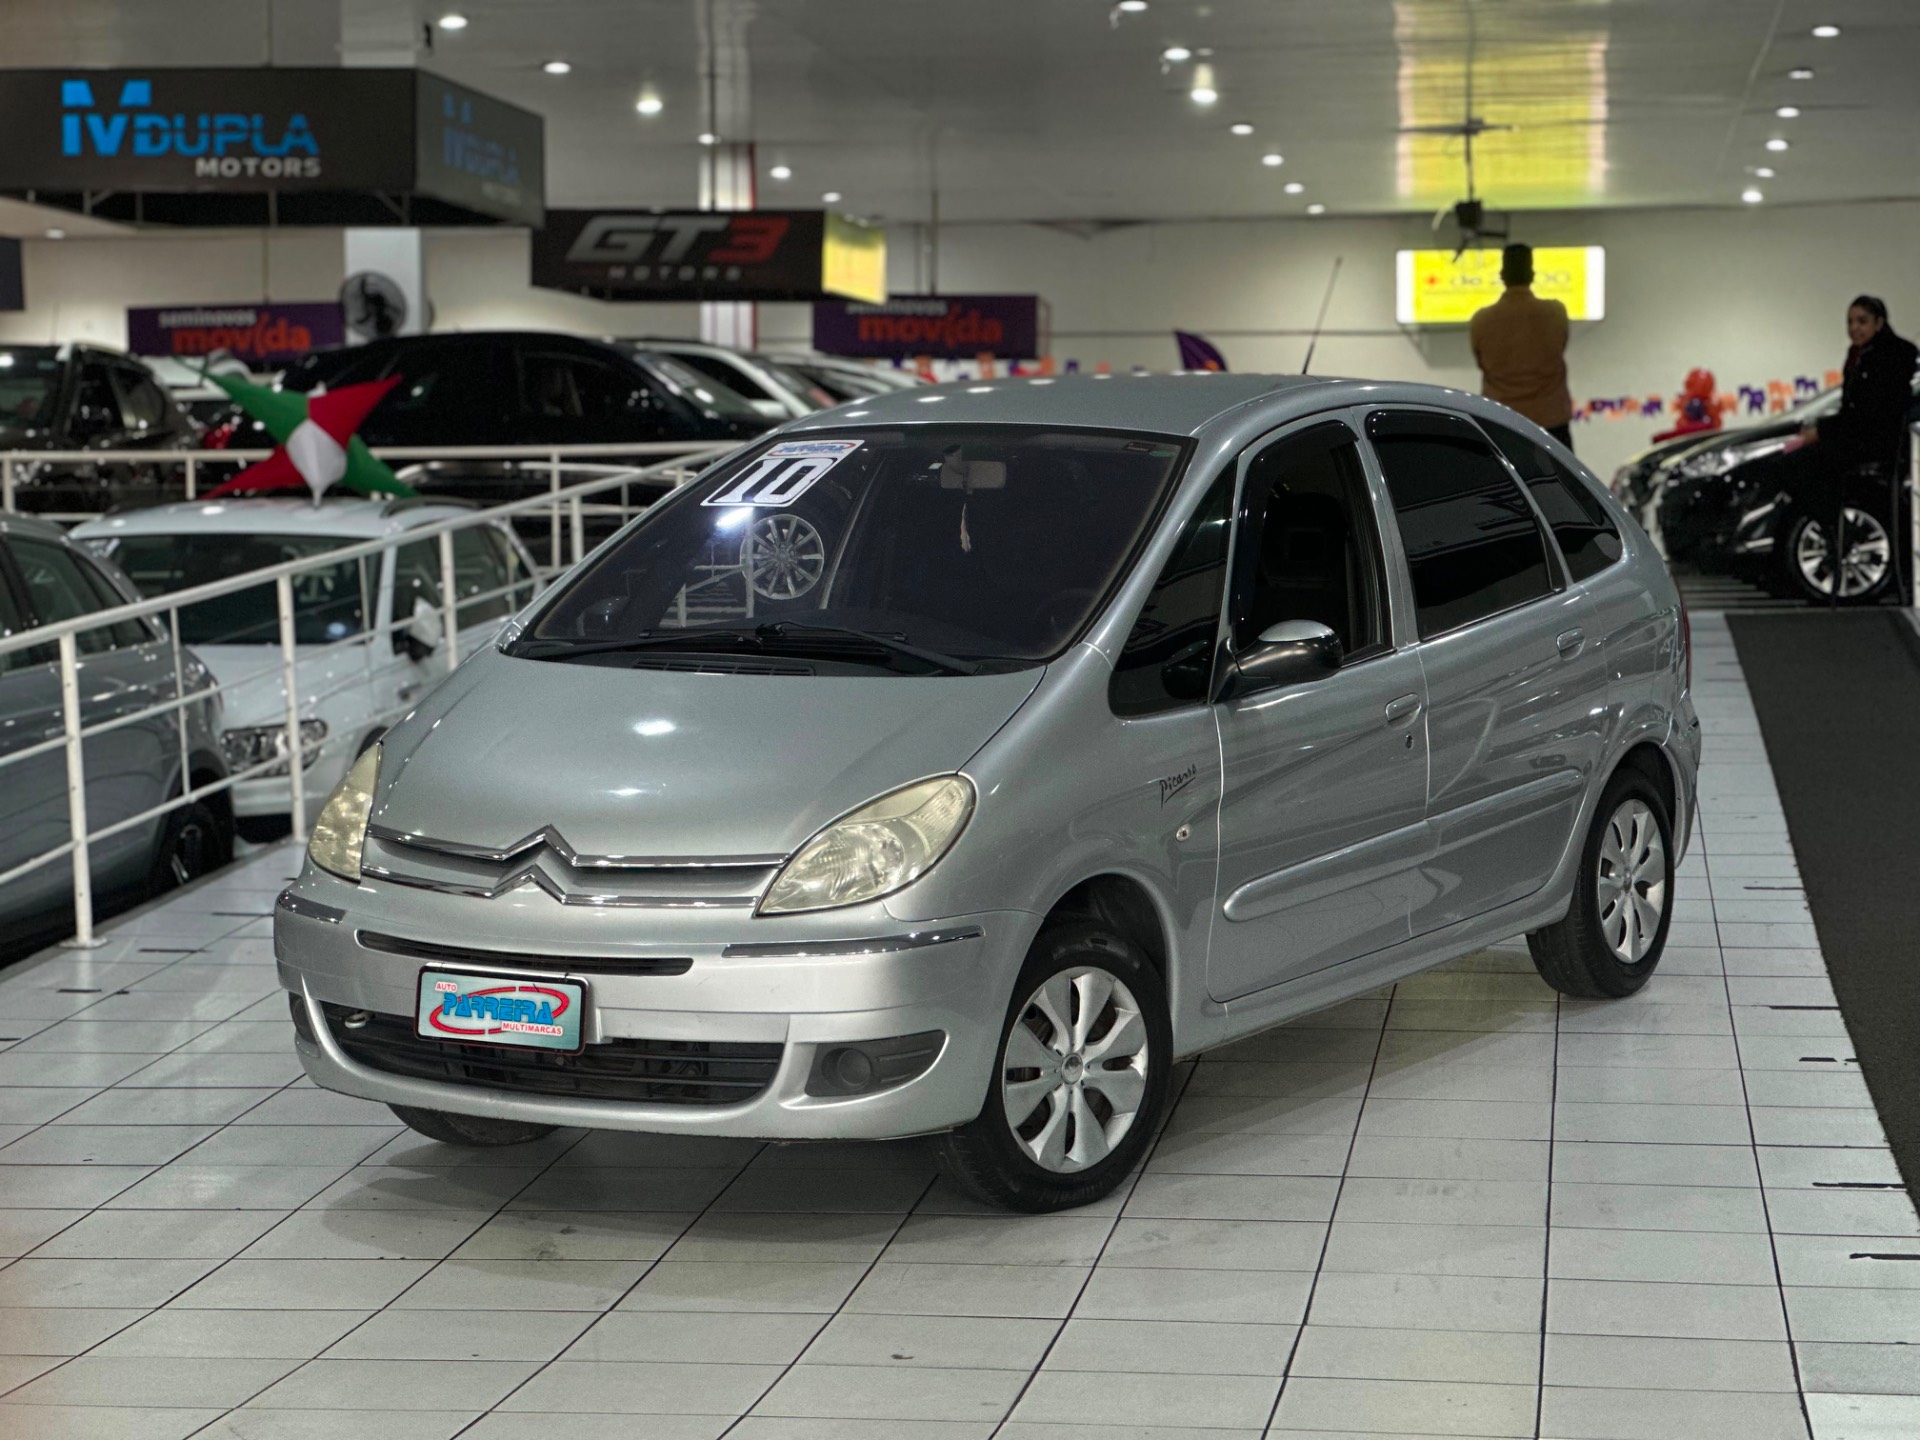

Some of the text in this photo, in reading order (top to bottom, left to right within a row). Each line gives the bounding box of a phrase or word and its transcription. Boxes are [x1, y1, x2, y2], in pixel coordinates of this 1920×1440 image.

[195, 157, 321, 178] MOTORS
[565, 215, 791, 263] GT3
[608, 265, 742, 281] MOTORS
[171, 309, 312, 357] movida
[711, 457, 836, 504] 10
[435, 982, 457, 992] AUTO
[442, 992, 554, 1025] PARREIRA
[502, 1022, 563, 1036] MULTIMARCAS
